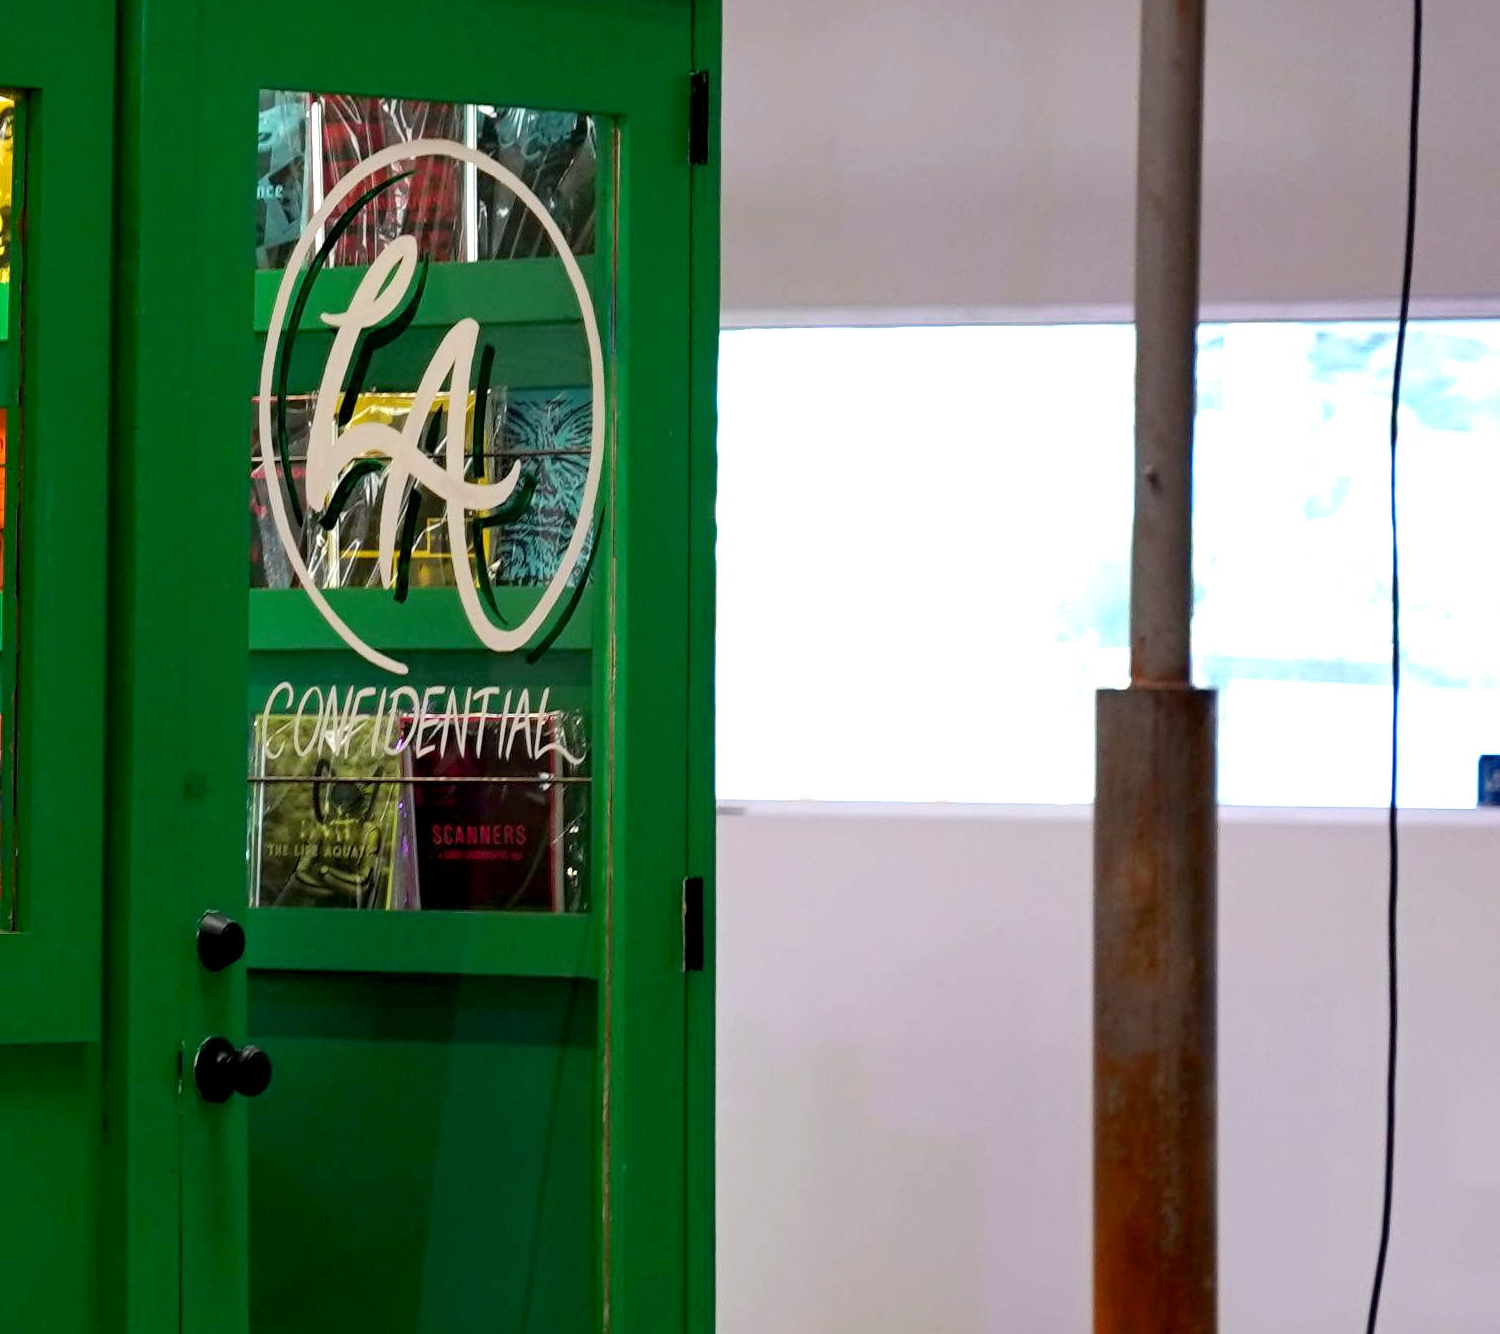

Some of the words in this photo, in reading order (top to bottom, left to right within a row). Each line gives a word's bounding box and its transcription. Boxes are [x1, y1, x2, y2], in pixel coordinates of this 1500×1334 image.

[262, 681, 587, 765] CONFIDENTIAL
[431, 823, 528, 847] SCANNERS
[267, 843, 289, 858] THE
